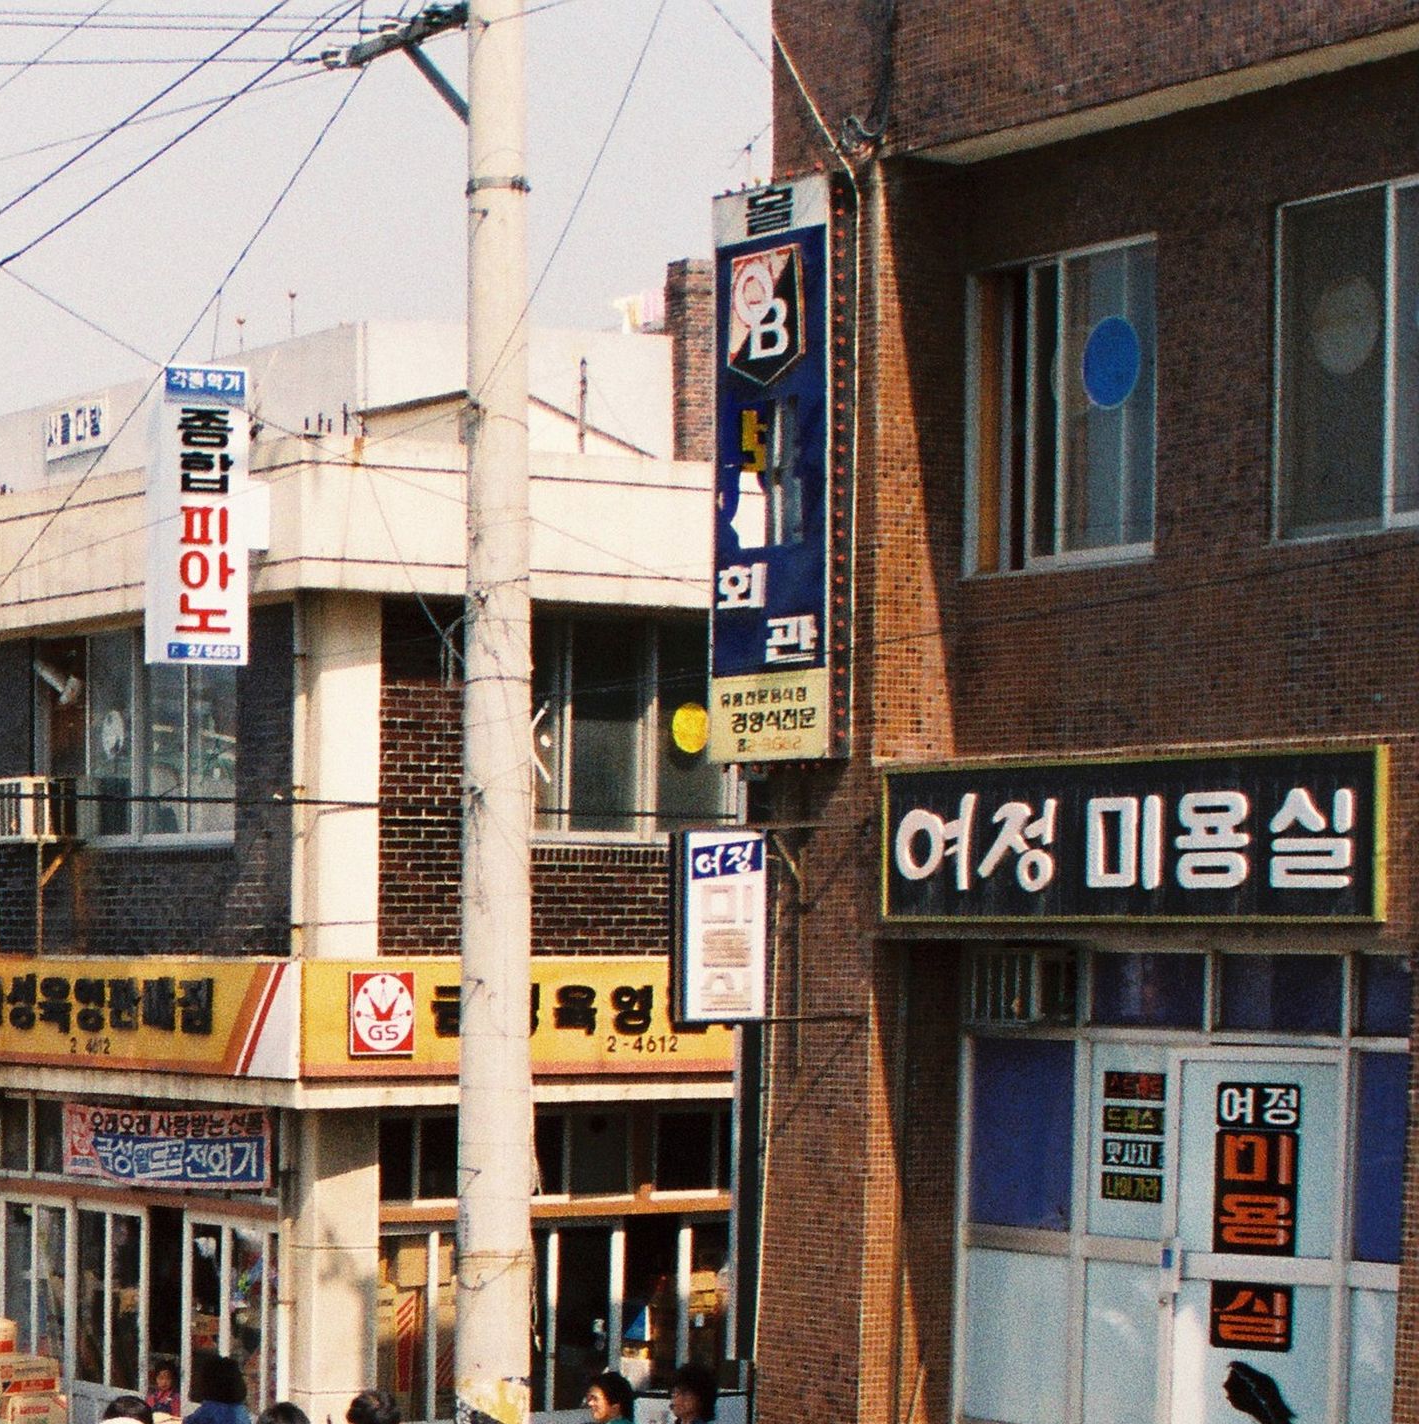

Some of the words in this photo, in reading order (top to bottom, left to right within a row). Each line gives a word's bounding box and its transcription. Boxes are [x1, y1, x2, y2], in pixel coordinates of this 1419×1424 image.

[731, 707, 816, 733] 경양식전문
[895, 792, 1057, 892] 여정
[1086, 787, 1354, 891] 미용실
[695, 840, 754, 876] 여정
[367, 1023, 400, 1041] GS
[606, 1035, 679, 1053] 2-4612
[1219, 1085, 1300, 1127] 여정
[186, 1141, 259, 1178] 전화기
[1213, 1133, 1294, 1347] 미용실
